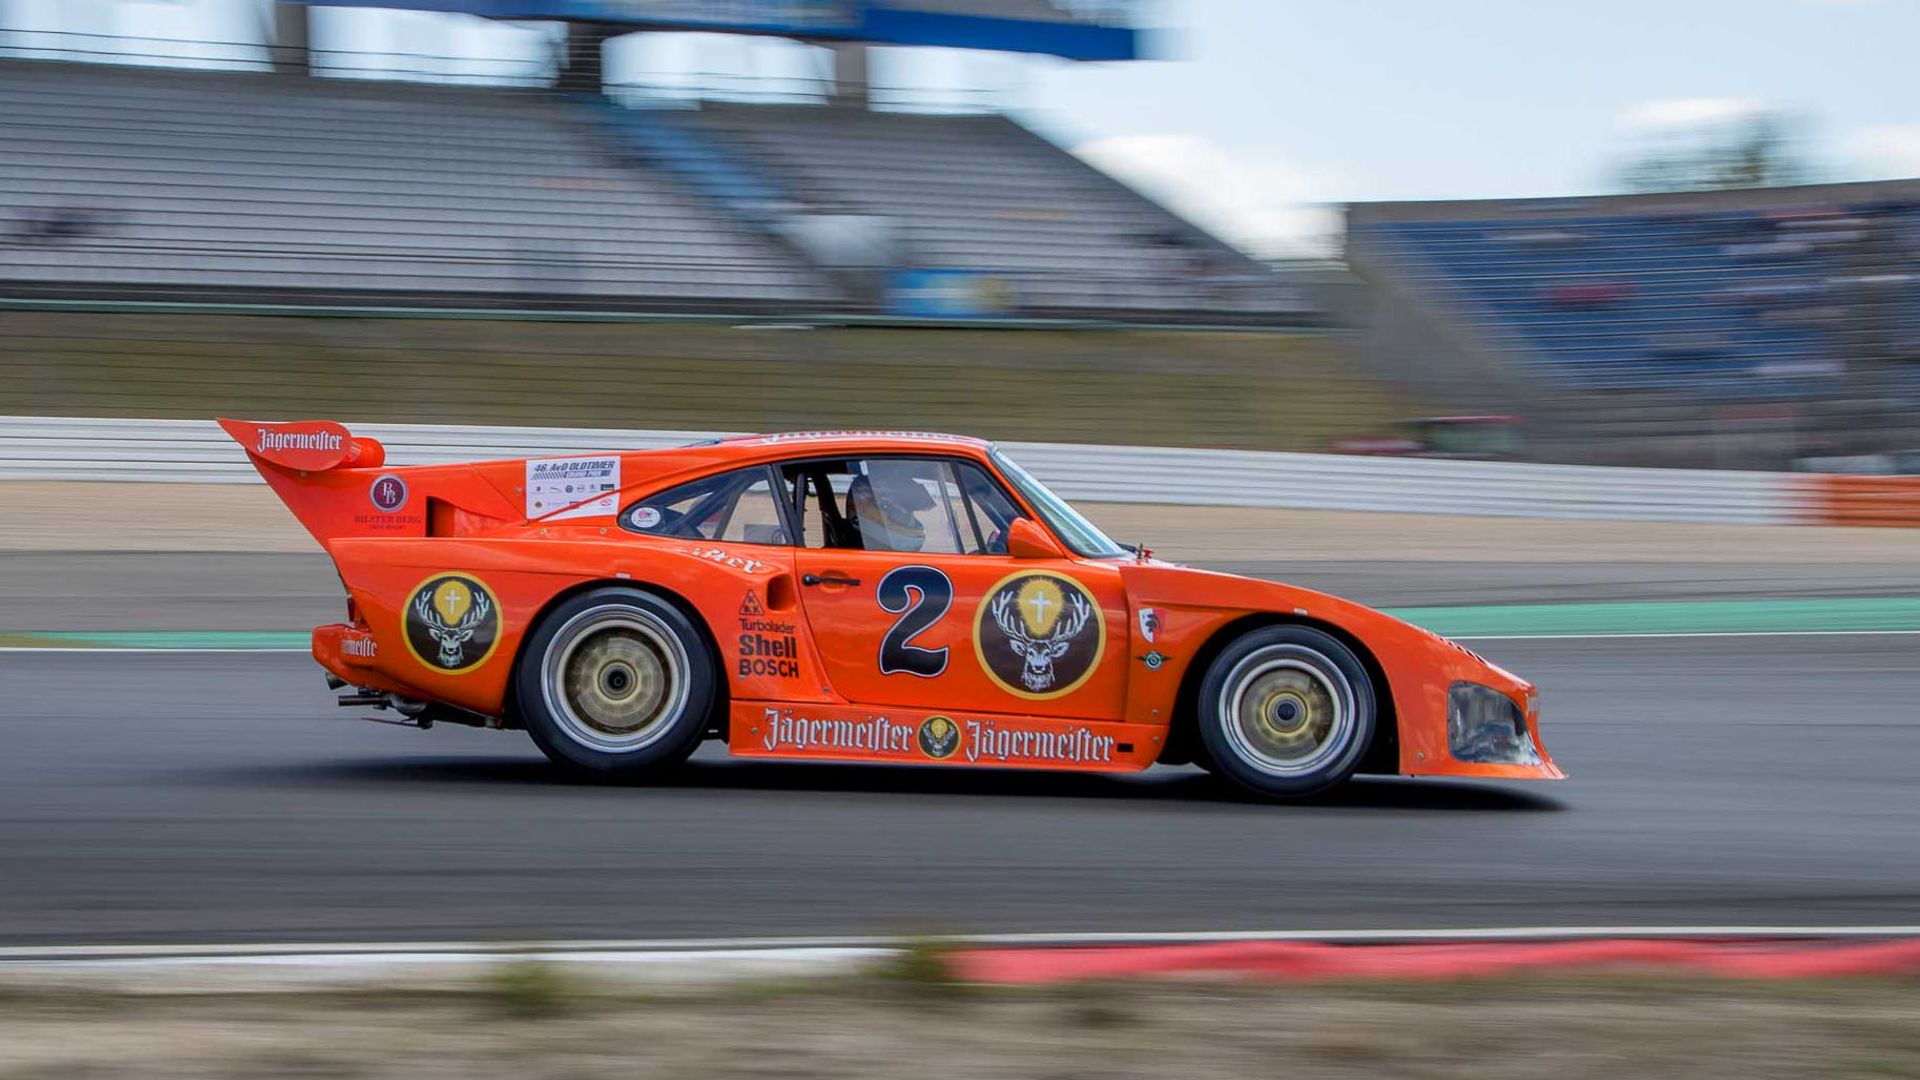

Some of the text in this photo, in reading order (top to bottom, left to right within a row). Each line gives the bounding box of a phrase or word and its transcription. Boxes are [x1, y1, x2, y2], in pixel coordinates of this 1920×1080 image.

[569, 460, 615, 470] OLDTIMER
[739, 618, 794, 633] Turbolader
[876, 565, 954, 678] 2
[739, 634, 797, 659] Shell
[739, 659, 799, 678] BOSCH
